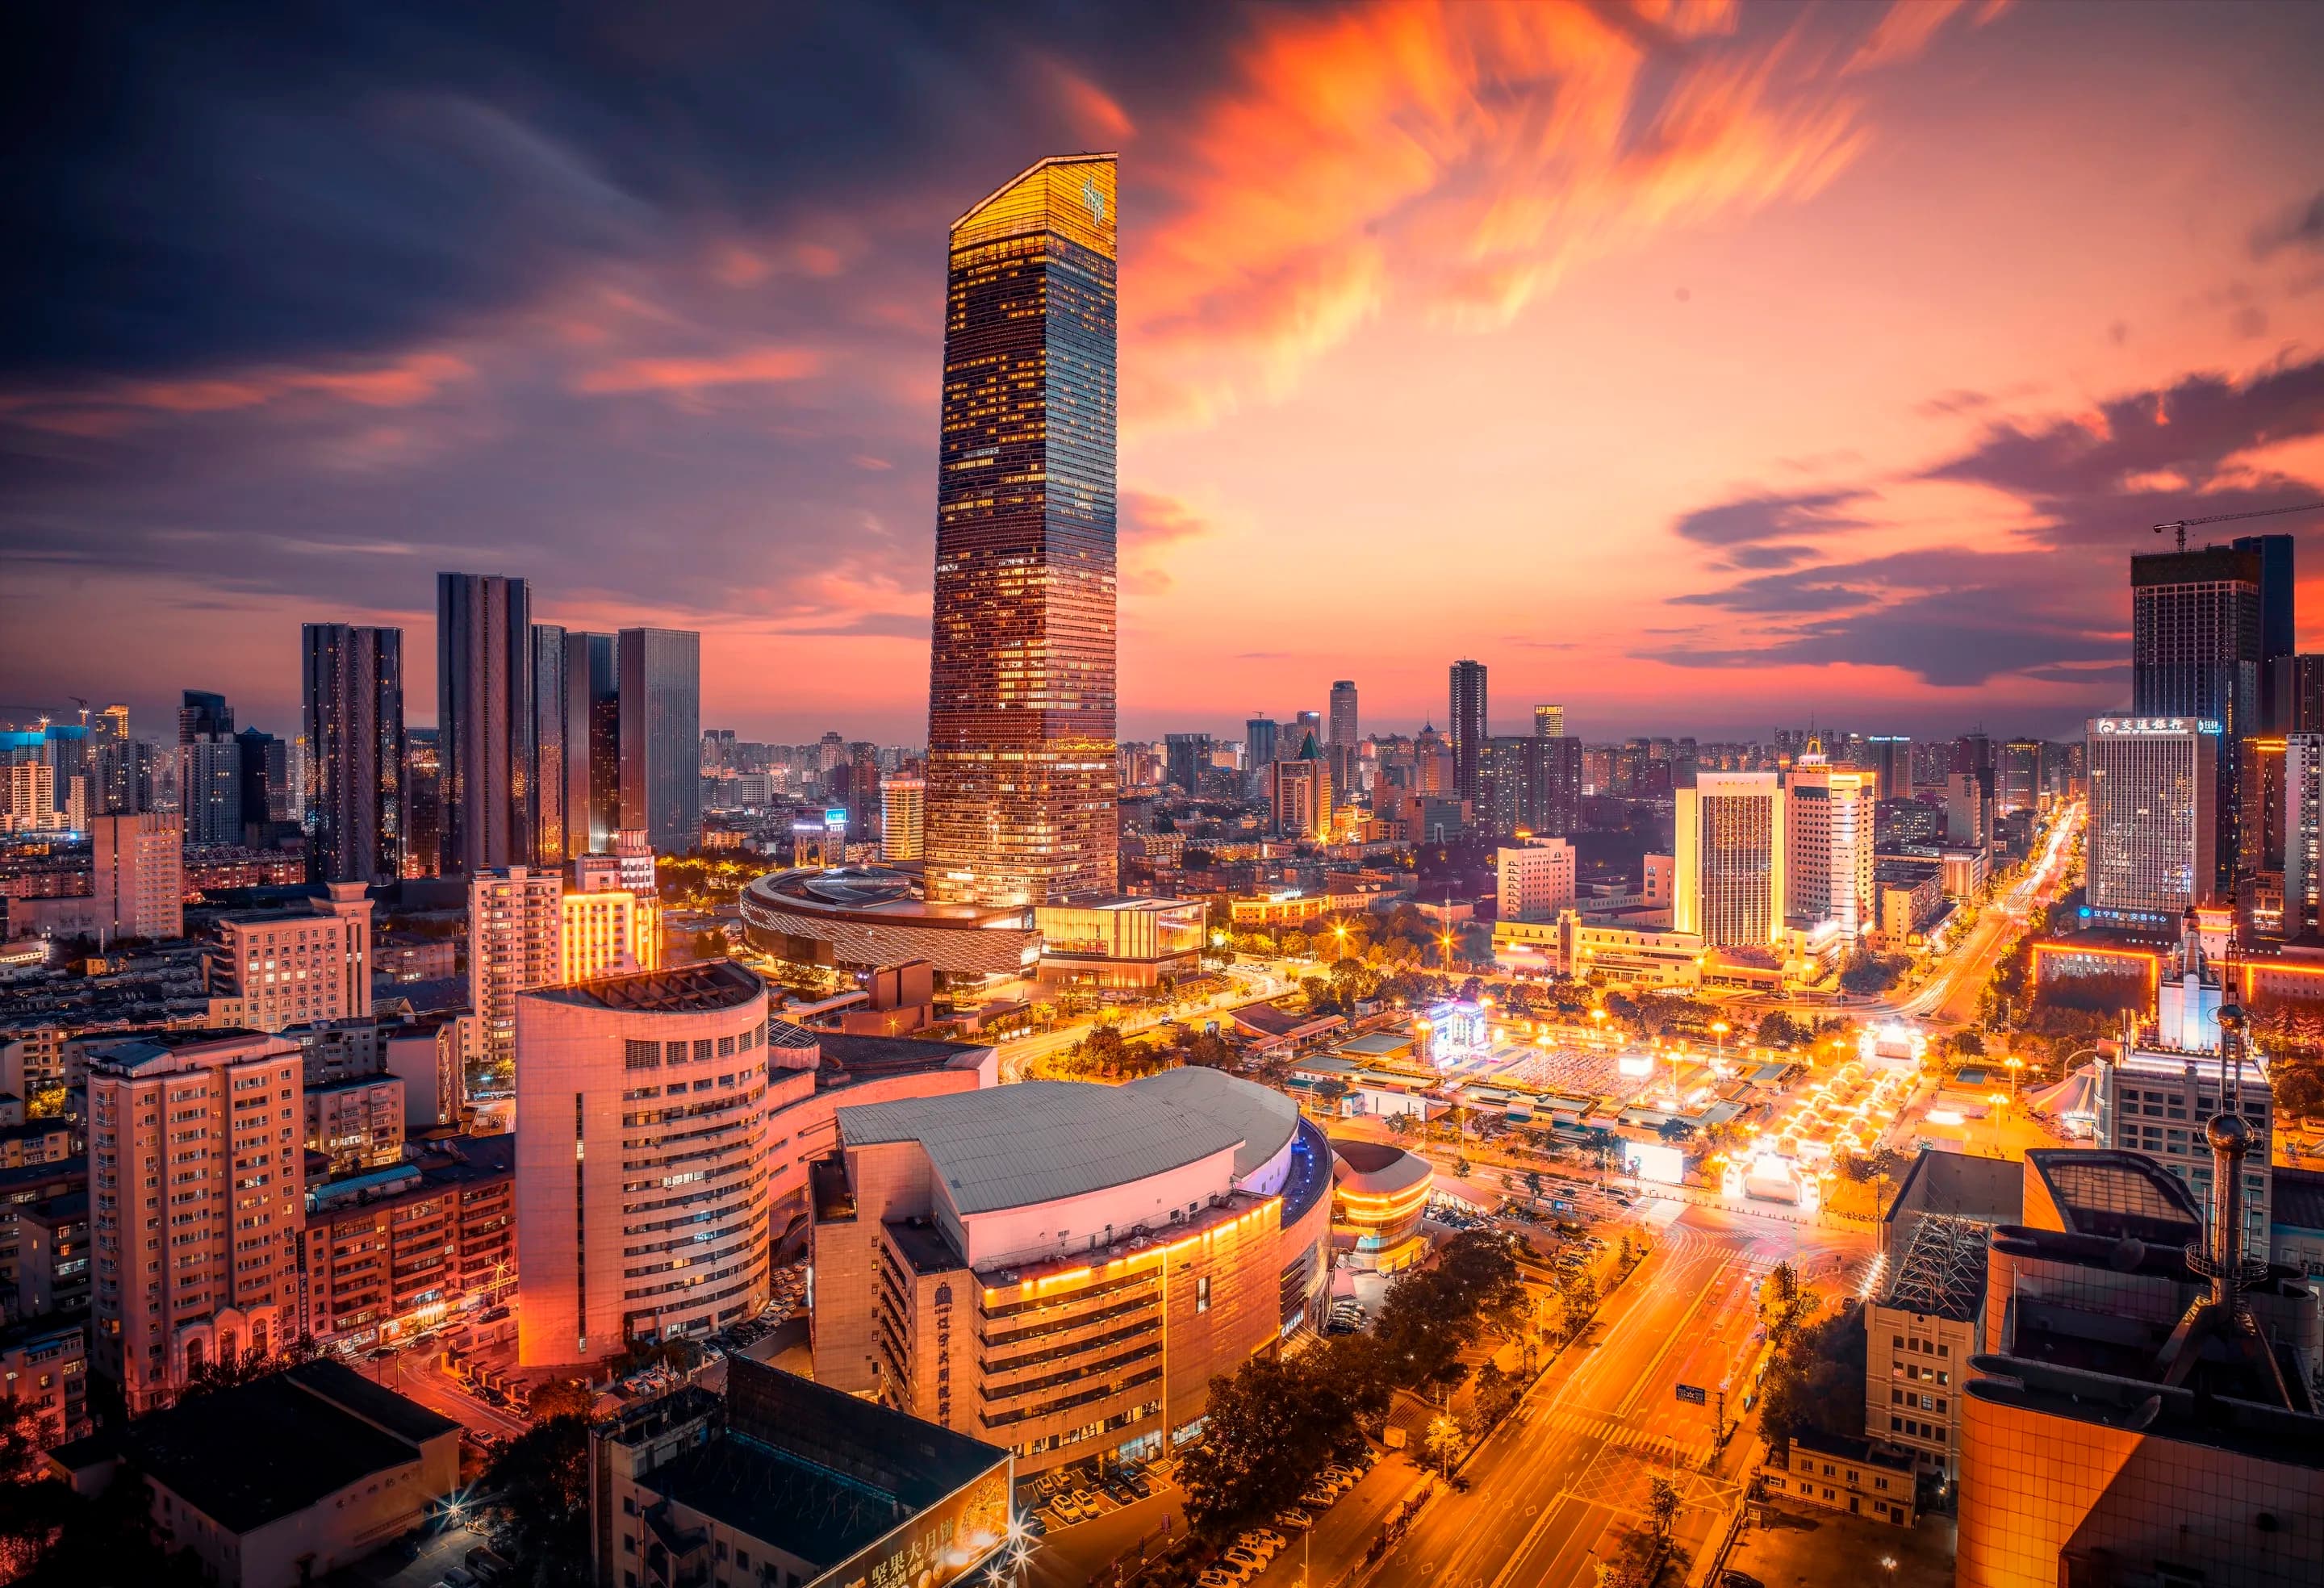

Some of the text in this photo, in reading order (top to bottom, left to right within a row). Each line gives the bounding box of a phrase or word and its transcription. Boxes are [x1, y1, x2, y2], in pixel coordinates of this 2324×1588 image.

[2094, 910, 2167, 922] 辽宁股交易中心
